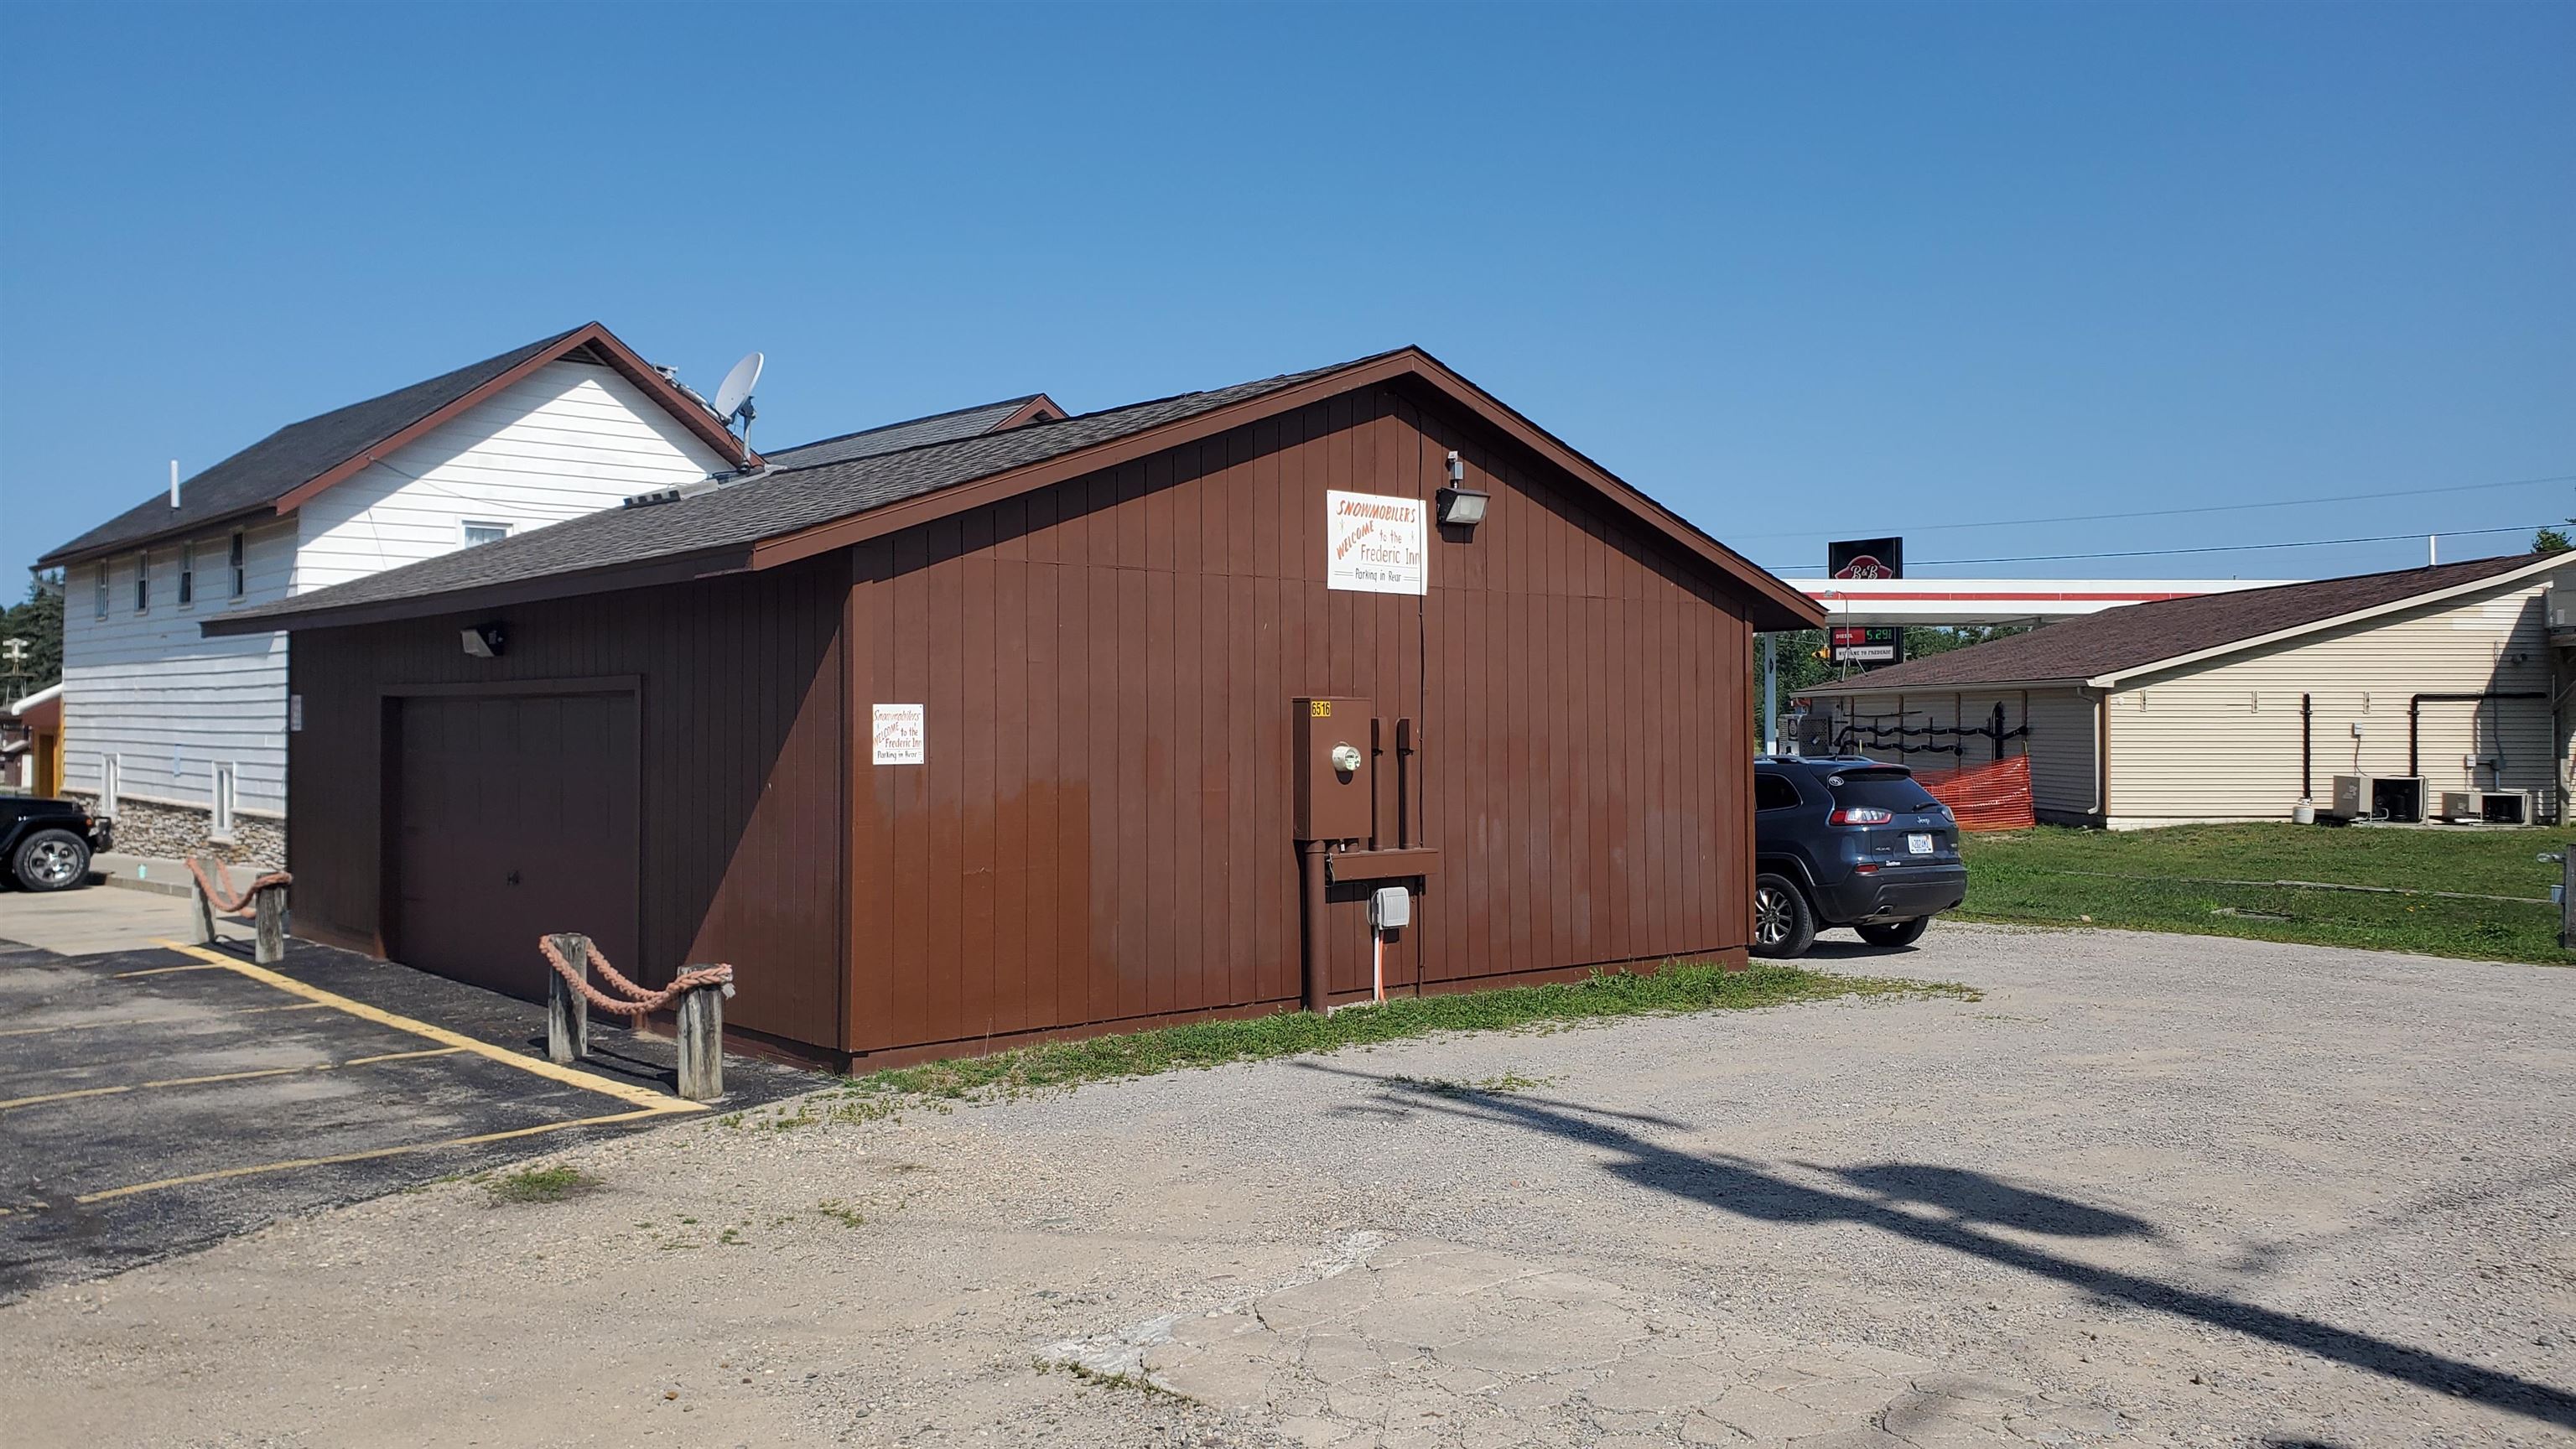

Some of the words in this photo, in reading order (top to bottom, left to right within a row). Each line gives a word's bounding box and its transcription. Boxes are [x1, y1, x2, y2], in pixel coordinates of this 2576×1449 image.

[1337, 500, 1415, 523] SNOWMOBILERS
[1336, 520, 1374, 560] WELCOME
[1379, 529, 1387, 543] to
[1390, 530, 1402, 543] the
[1361, 544, 1401, 564] Frederic
[1405, 548, 1420, 565] Inn
[1355, 568, 1377, 583] Parking
[1379, 569, 1385, 581] in
[1389, 571, 1402, 582] Rear
[1311, 703, 1330, 715] 6516
[901, 727, 907, 736] to
[909, 727, 918, 736] the
[885, 738, 911, 749] Frederic
[912, 737, 922, 748] Inn
[877, 750, 897, 761] Parking
